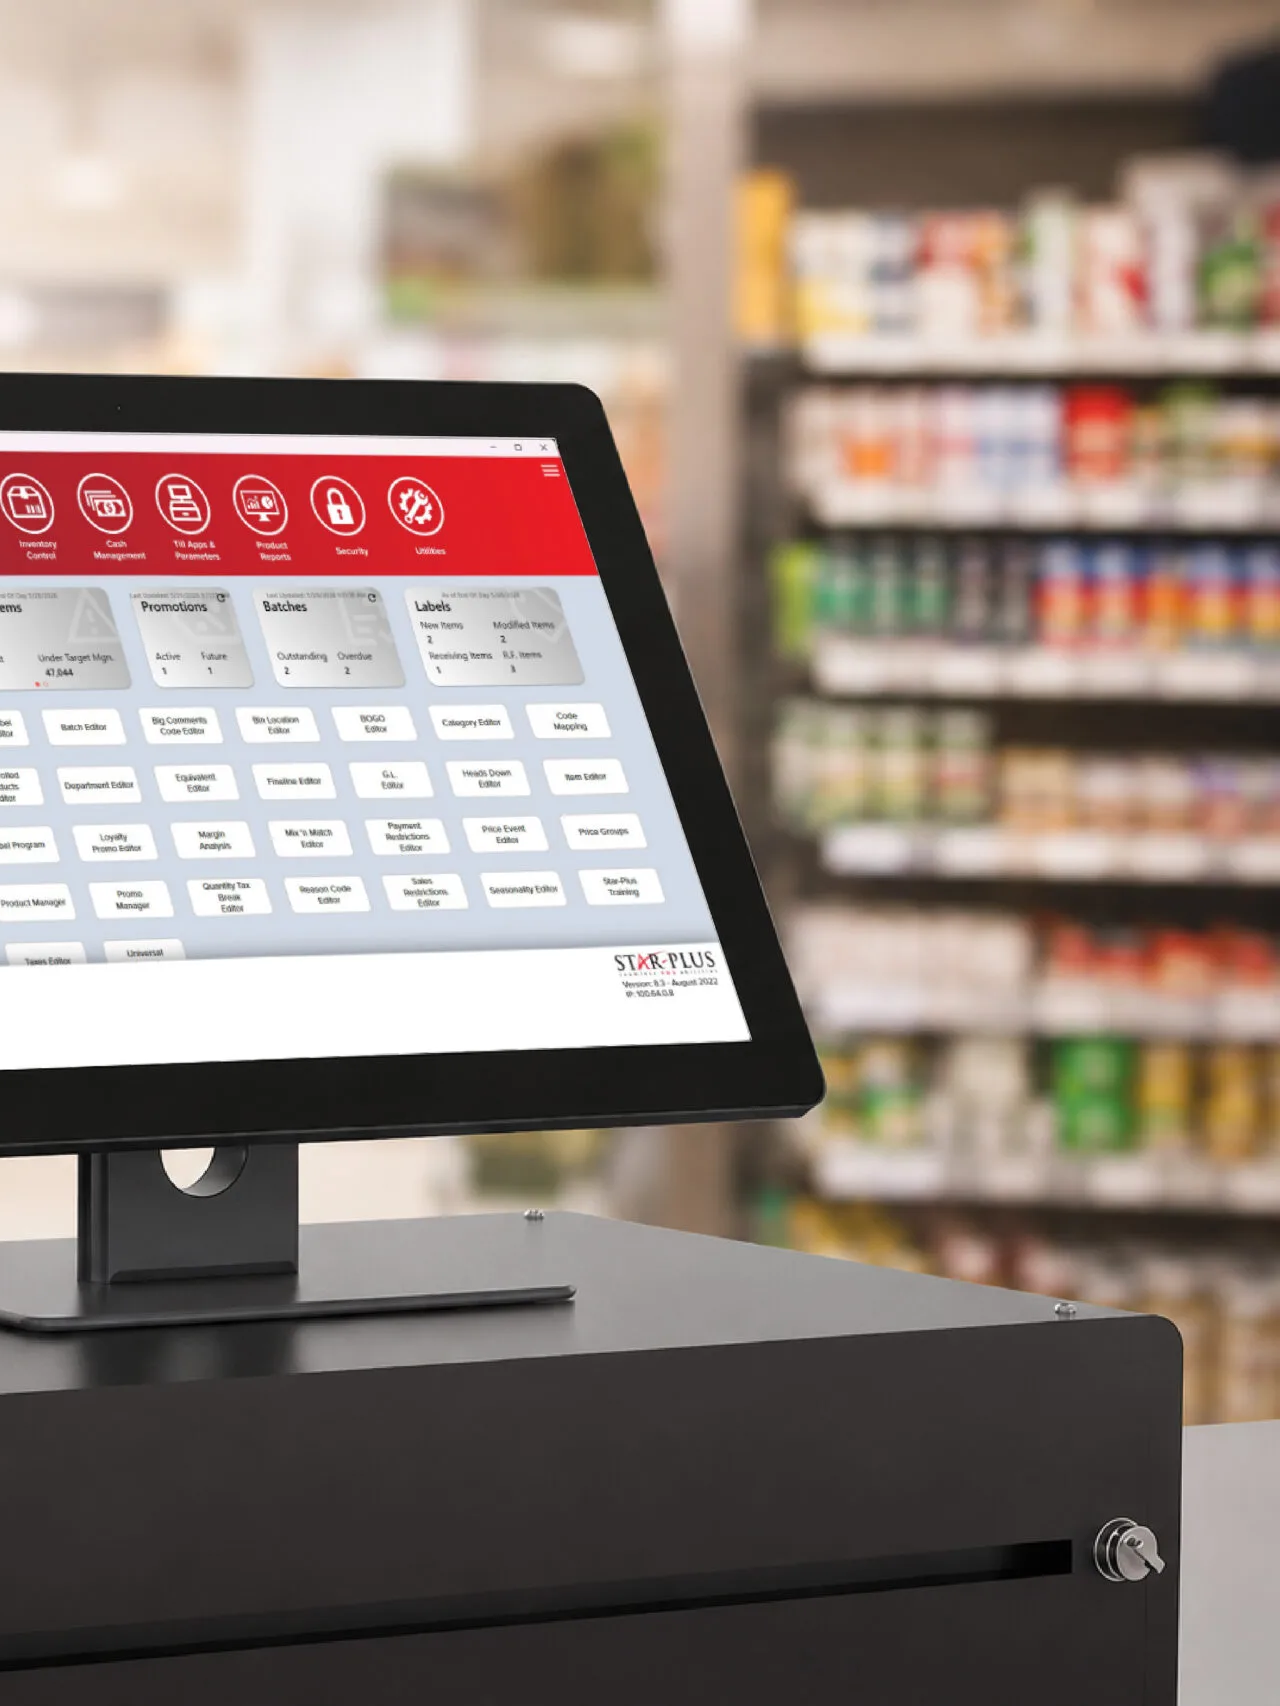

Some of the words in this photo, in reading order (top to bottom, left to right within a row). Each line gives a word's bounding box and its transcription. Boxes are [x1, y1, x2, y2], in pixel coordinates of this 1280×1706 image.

[19, 539, 57, 551] Inventory
[105, 539, 127, 548] Cash
[174, 540, 186, 549] Till
[187, 540, 204, 551] Apps
[206, 540, 215, 549] &
[256, 541, 288, 550] Product
[335, 546, 368, 557] Security
[415, 546, 446, 555] Utilities
[26, 551, 56, 560] Control
[94, 551, 146, 562] Management
[174, 552, 221, 561] Parameters
[260, 553, 291, 563] Reports
[141, 601, 207, 613] Promotions
[263, 600, 307, 613] Batches
[415, 600, 451, 613] Labels
[420, 621, 438, 630] New
[440, 621, 463, 630] Items
[493, 621, 528, 630] Modified
[531, 621, 555, 630] Items
[38, 652, 62, 663] Under
[64, 653, 89, 665] Target
[155, 651, 181, 661] Active
[200, 651, 227, 661] Future
[277, 651, 328, 663] Outstanding
[337, 651, 373, 661] Overdue
[429, 651, 468, 662] Receiving
[471, 651, 493, 661] Items
[519, 651, 542, 660] Items
[252, 716, 264, 724] Bin
[266, 716, 300, 724] Location
[360, 714, 385, 723] BOGO
[556, 711, 578, 720] Code
[151, 716, 164, 726] Big
[166, 716, 207, 725] Comments
[442, 718, 476, 729] Category
[478, 718, 501, 727] Editor
[60, 723, 81, 732] Batch
[83, 723, 107, 732] Editor
[160, 727, 180, 736] Code
[182, 727, 205, 736] Editor
[268, 726, 290, 734] Editor
[364, 725, 387, 733] Editor
[553, 722, 588, 732] Mapping
[175, 773, 216, 783] Equivalent
[462, 769, 487, 778] Heads
[489, 769, 512, 778] Down
[565, 773, 581, 782] Item
[583, 773, 607, 782] Editor
[267, 777, 297, 786] Fineline
[299, 776, 321, 785] Editor
[381, 781, 404, 790] Editor
[478, 780, 501, 789] Editor
[64, 781, 110, 791] Department
[112, 781, 134, 789] Editor
[187, 784, 210, 793] Editor
[387, 821, 421, 831] Payment
[482, 825, 501, 833] Price
[504, 824, 526, 833] Event
[199, 830, 225, 840] Margin
[285, 828, 298, 837] Mix
[309, 828, 333, 837] Match
[385, 832, 430, 841] Restrictions
[578, 827, 598, 836] Price
[600, 827, 629, 837] Groups
[100, 833, 128, 843] Loyalty
[496, 836, 519, 845] Editor
[12, 841, 45, 851] Program
[200, 842, 232, 852] Analysis
[300, 839, 324, 848] Editor
[399, 843, 422, 852] Editor
[92, 844, 118, 853] Promo
[119, 844, 142, 852] Editor
[411, 877, 433, 885] Sales
[603, 876, 637, 886] Star-Plus
[203, 882, 234, 892] Quantity
[236, 882, 251, 890] Tax
[299, 885, 328, 894] Reason
[330, 884, 352, 893] Code
[403, 887, 448, 896] Restrictions
[490, 885, 533, 896] Seasonality
[535, 884, 558, 894] Editor
[117, 890, 142, 899] Promo
[607, 887, 639, 898] Training
[218, 893, 241, 902] Break
[318, 896, 341, 905] Editor
[1, 899, 30, 908] Product
[32, 898, 66, 908] Manager
[116, 902, 150, 912] Manager
[417, 898, 441, 907] Editor
[221, 904, 244, 913] Editor
[127, 949, 163, 958] Universal
[48, 957, 71, 965] Editor
[614, 951, 716, 971] STAR-PLUS
